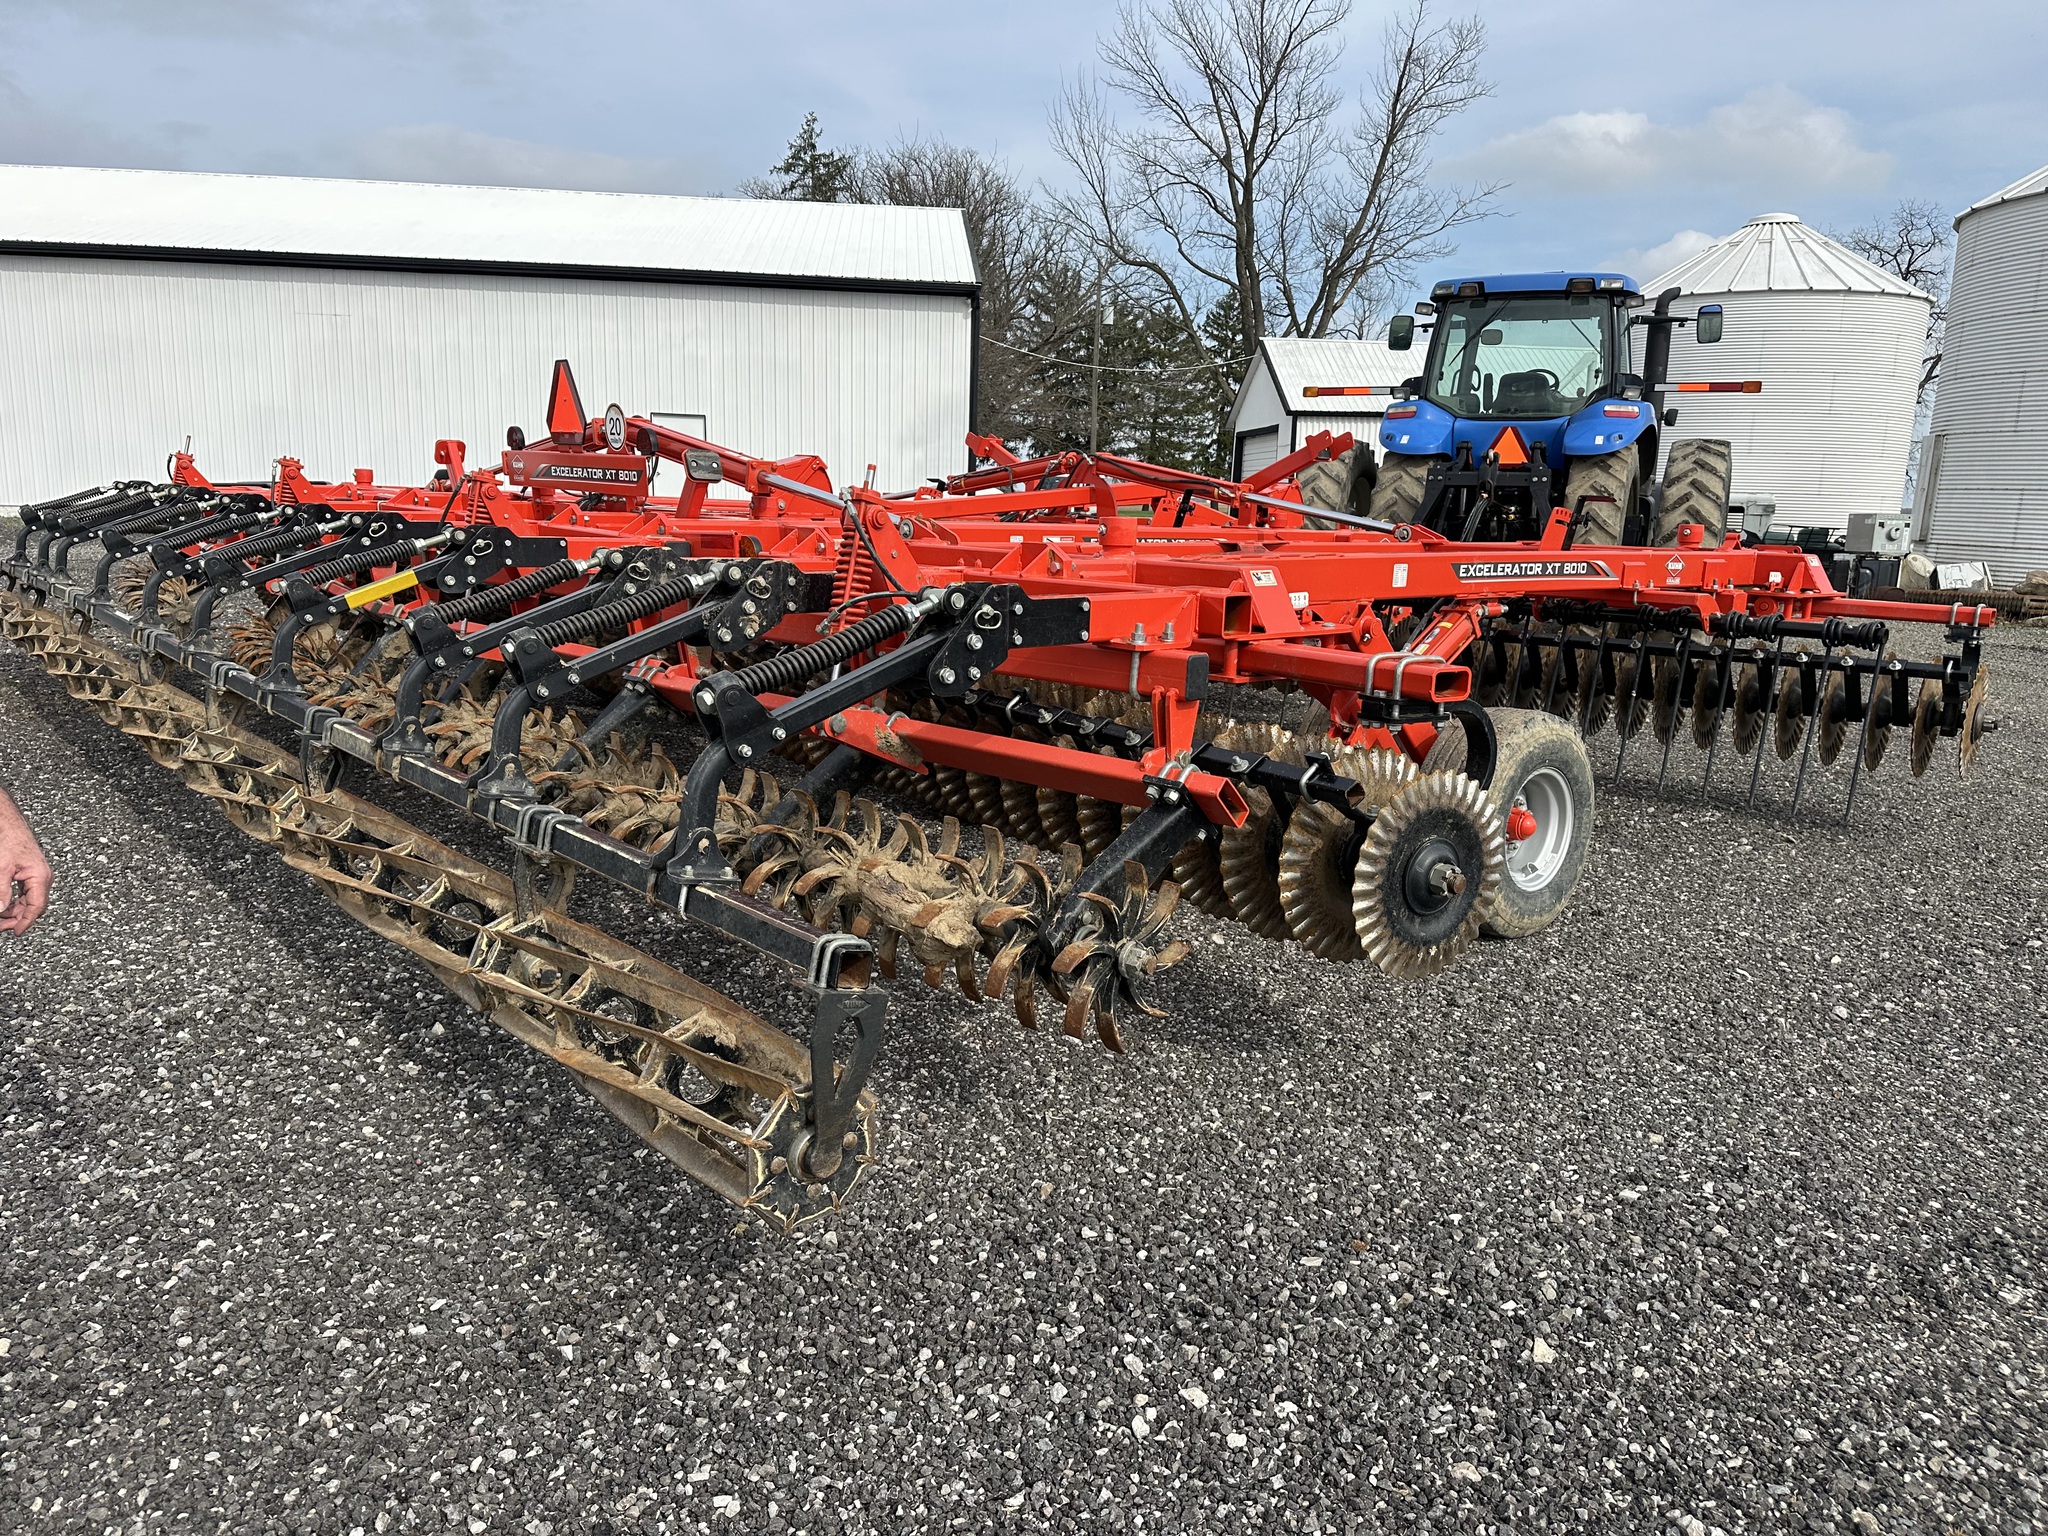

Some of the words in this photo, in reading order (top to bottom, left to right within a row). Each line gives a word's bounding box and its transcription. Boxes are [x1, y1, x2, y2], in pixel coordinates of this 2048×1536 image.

[608, 417, 622, 437] 20
[551, 466, 603, 479] EXCELERATOR
[605, 469, 616, 480] XT
[618, 470, 638, 481] 8010
[1459, 562, 1542, 577] EXCELERATOR
[1545, 563, 1562, 575] XT
[1563, 562, 1587, 574] 8010
